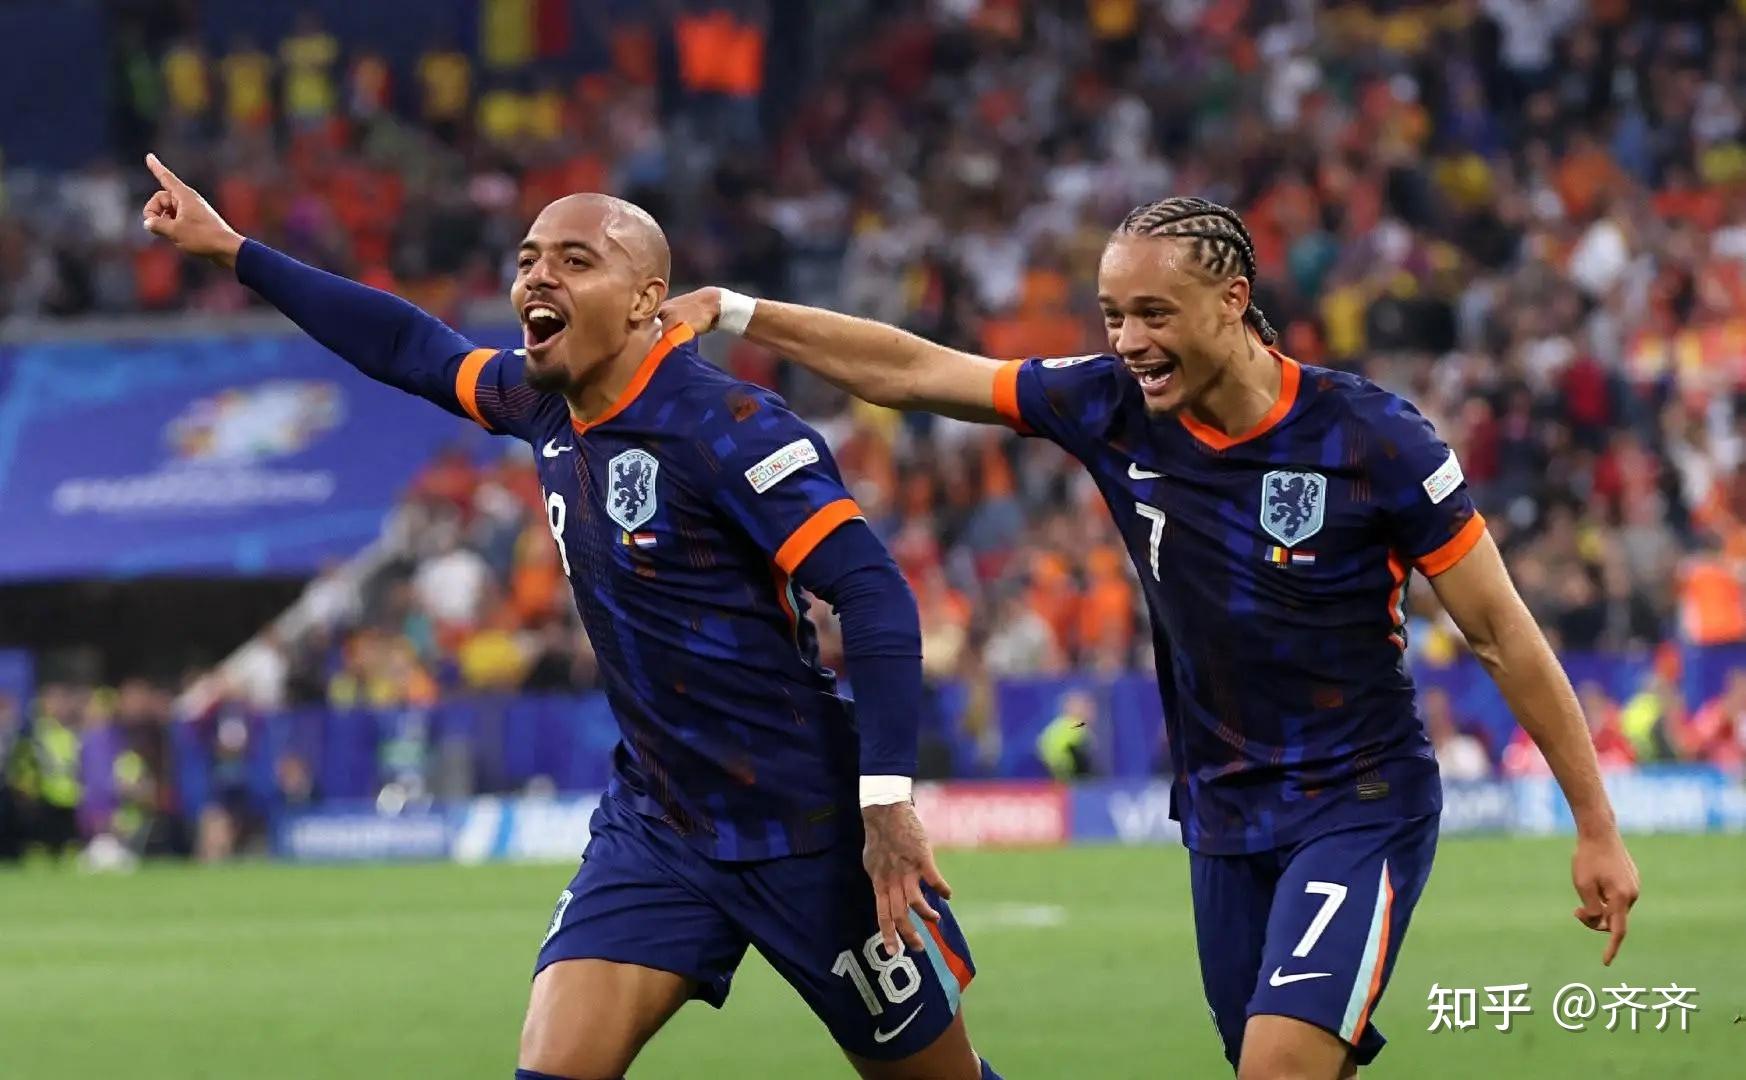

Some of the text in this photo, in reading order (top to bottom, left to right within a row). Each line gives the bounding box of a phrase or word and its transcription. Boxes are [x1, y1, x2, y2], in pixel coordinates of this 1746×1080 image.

[1135, 501, 1166, 581] 7
[1292, 881, 1348, 957] 7
[830, 929, 922, 1016] 18
